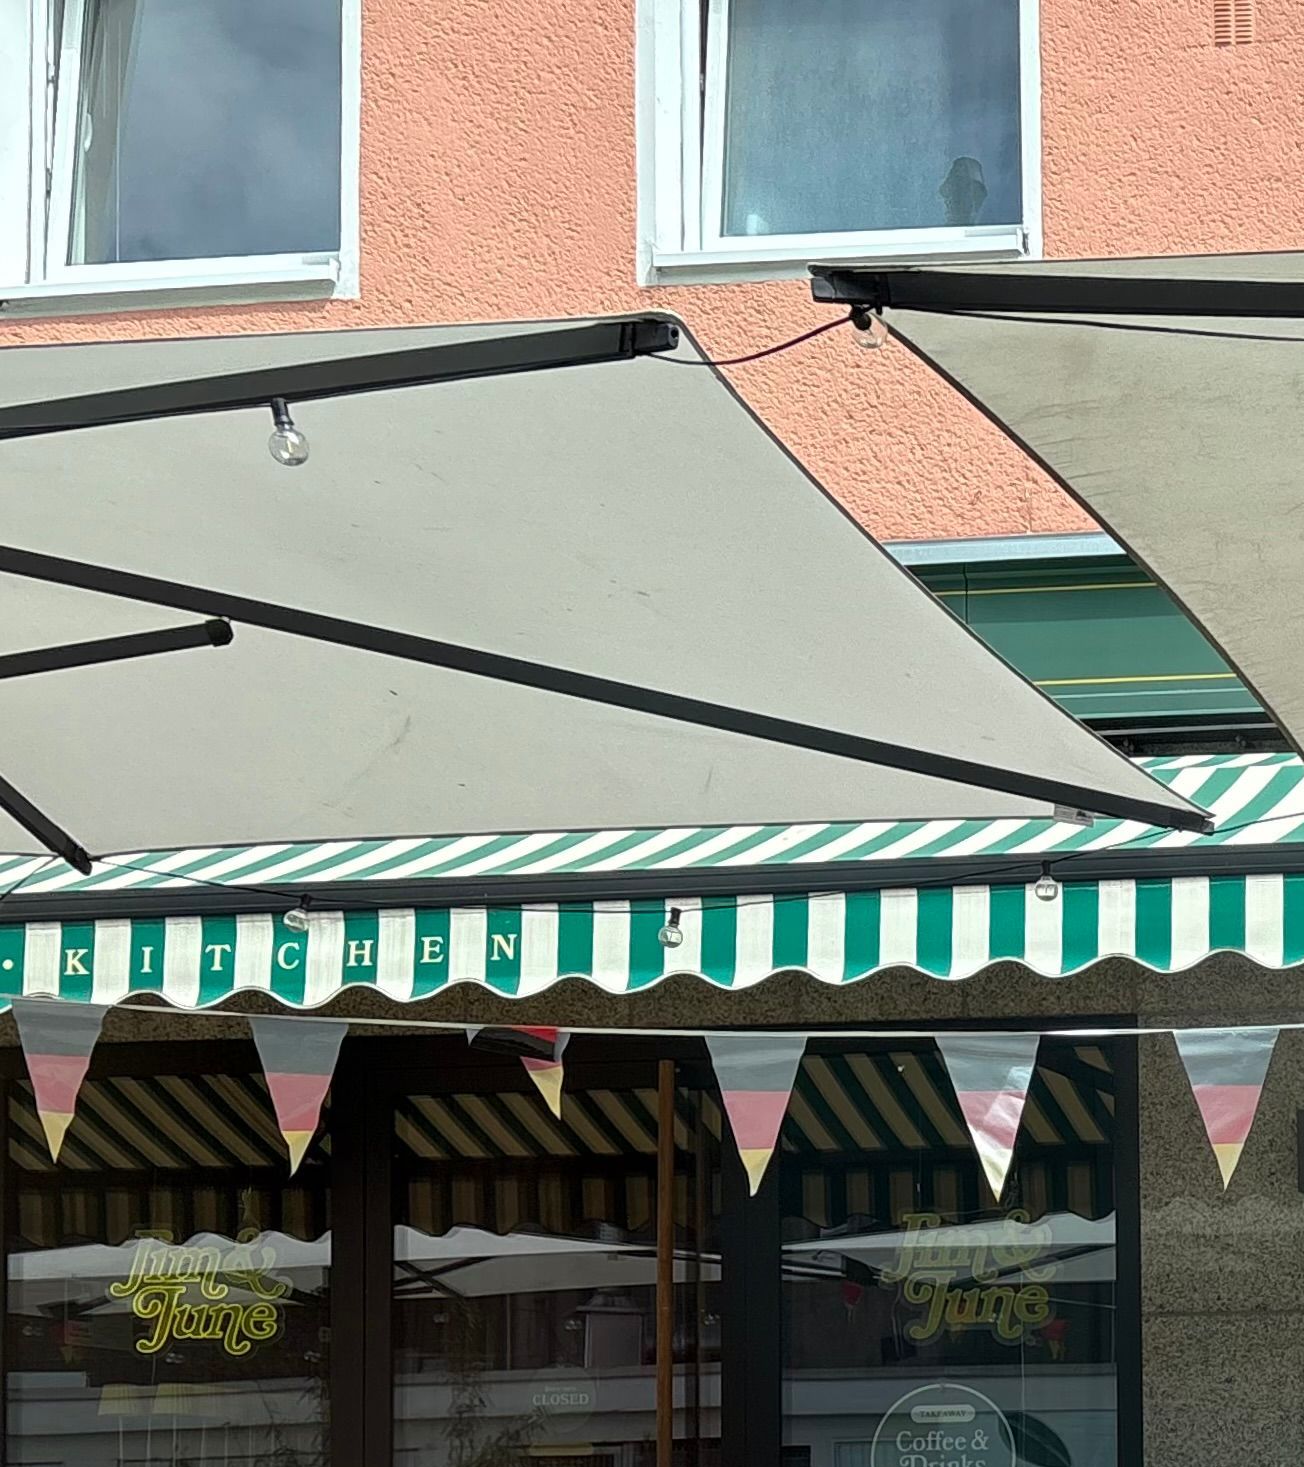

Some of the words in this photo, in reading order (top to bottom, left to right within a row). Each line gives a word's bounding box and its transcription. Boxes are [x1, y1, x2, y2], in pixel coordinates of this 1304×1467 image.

[63, 933, 520, 976] KITCHEN
[109, 1229, 229, 1300] Jim
[132, 1285, 278, 1356] June
[904, 1269, 1050, 1340] June
[531, 1391, 591, 1407] CLOSED
[895, 1430, 967, 1452] Coffee
[970, 1428, 990, 1451] &
